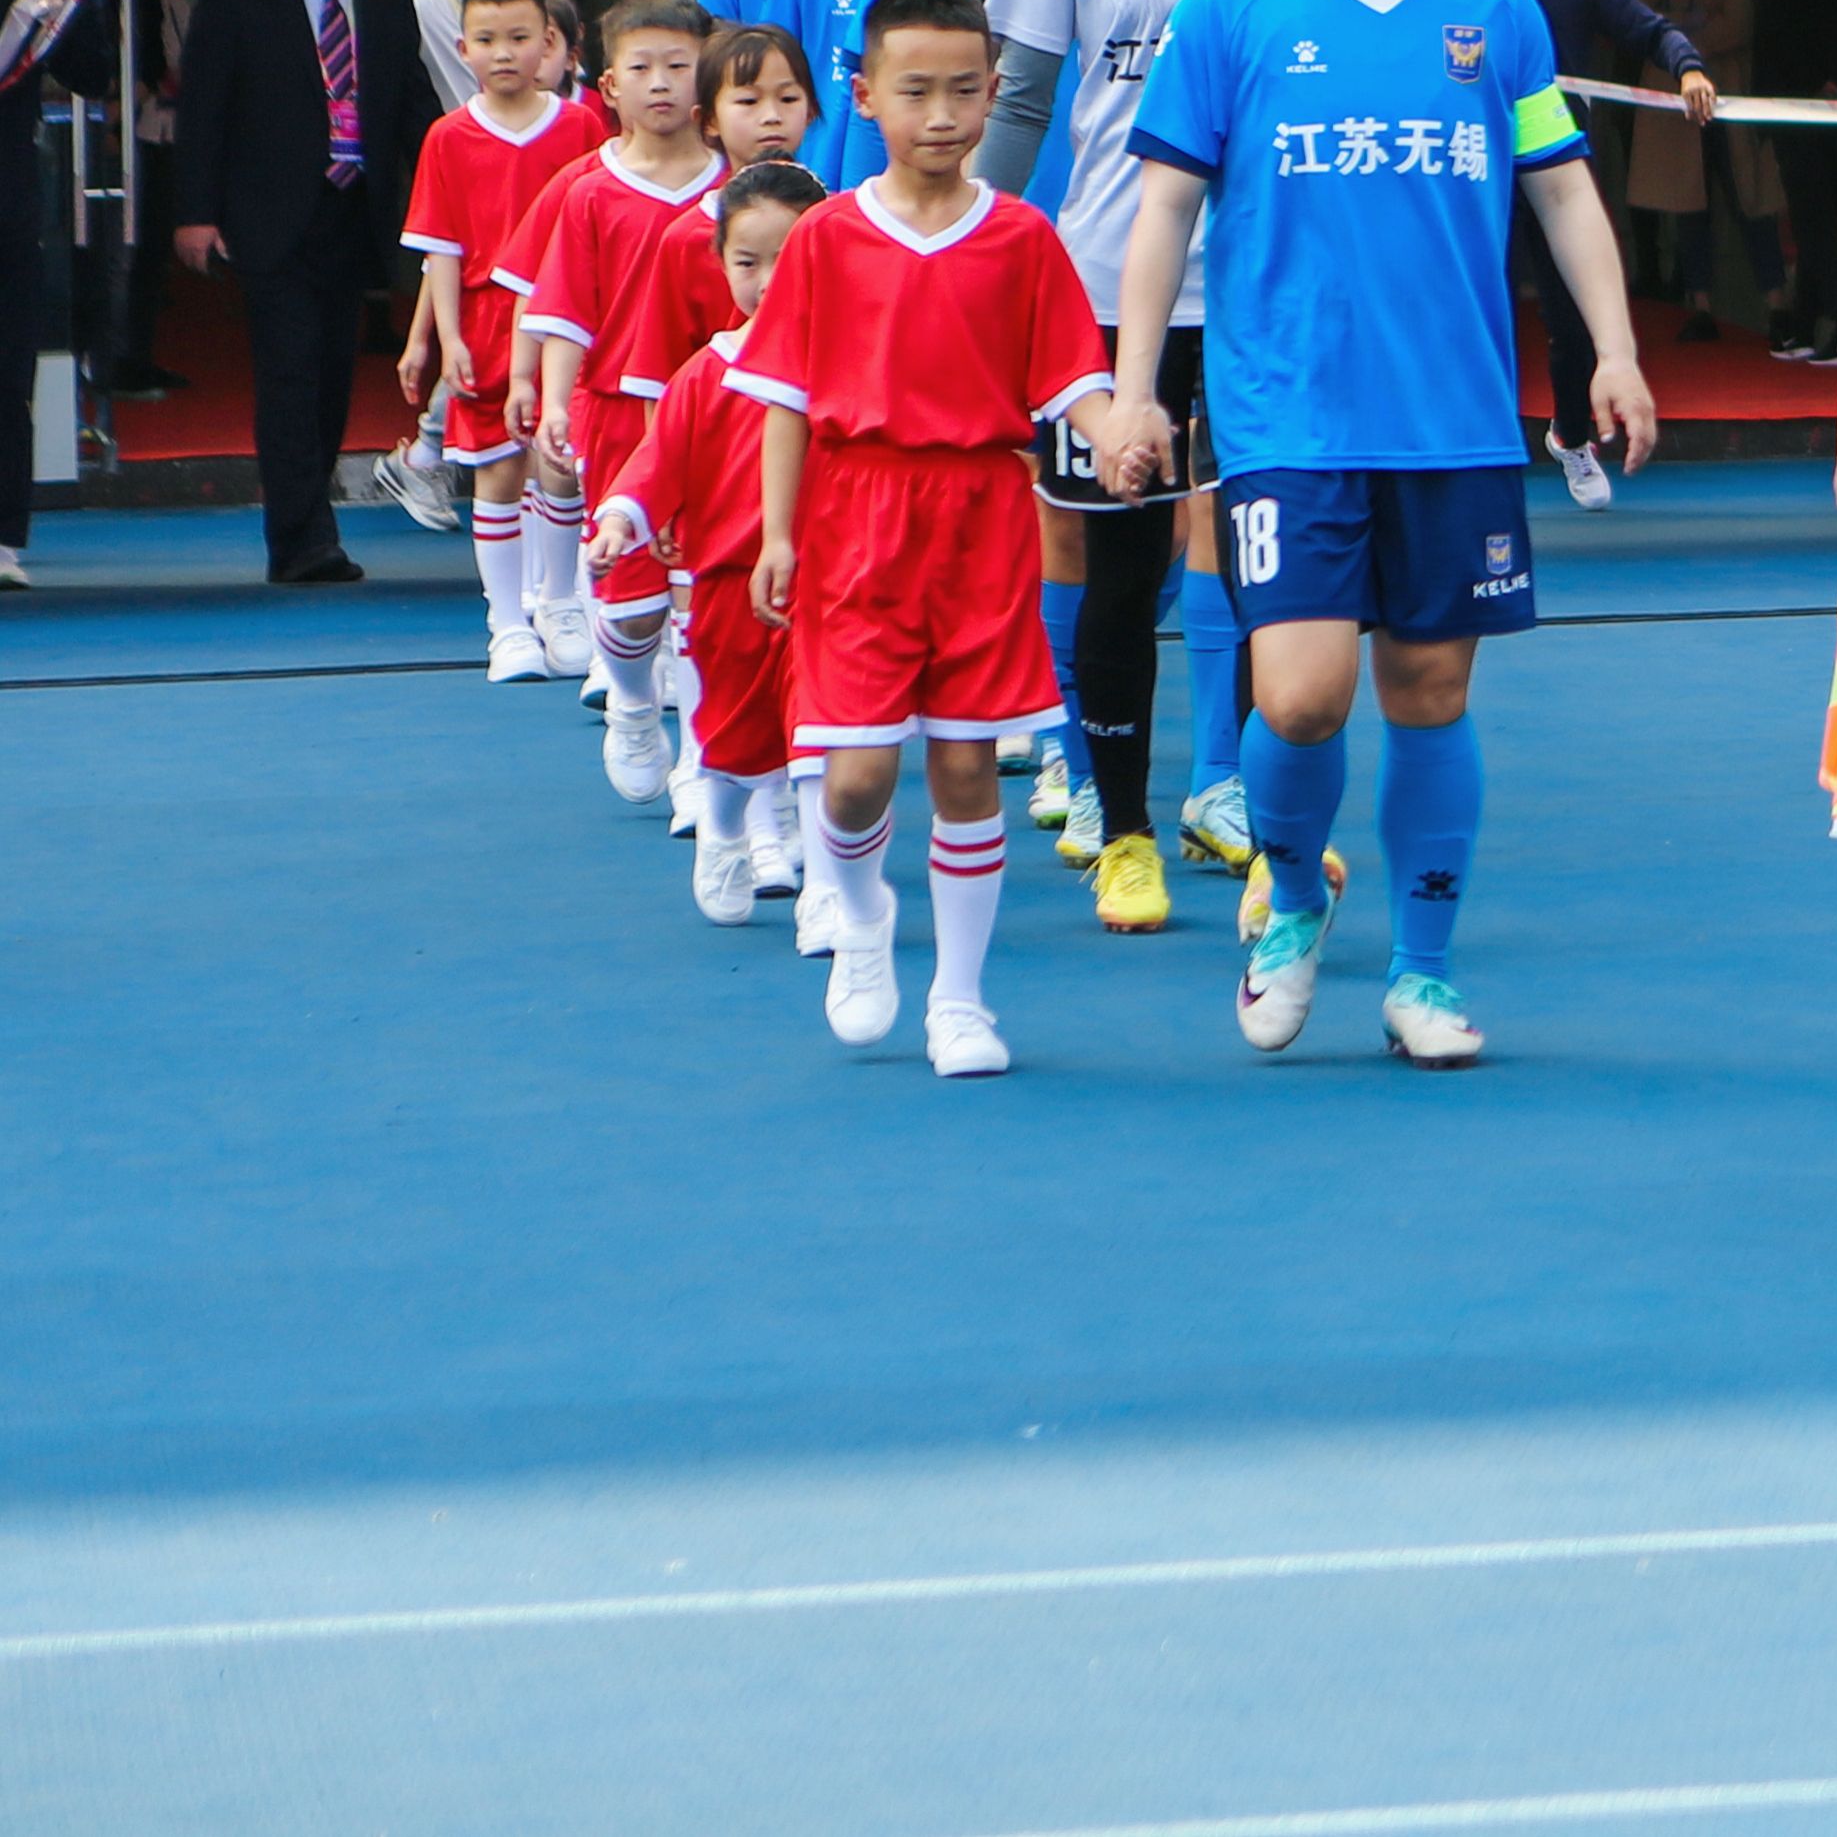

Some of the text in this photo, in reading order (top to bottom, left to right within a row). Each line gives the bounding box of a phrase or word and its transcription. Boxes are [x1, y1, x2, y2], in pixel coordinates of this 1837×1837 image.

[1287, 64, 1327, 73] KELME
[1272, 116, 1489, 182] 江苏无锡
[1230, 498, 1279, 587] 18
